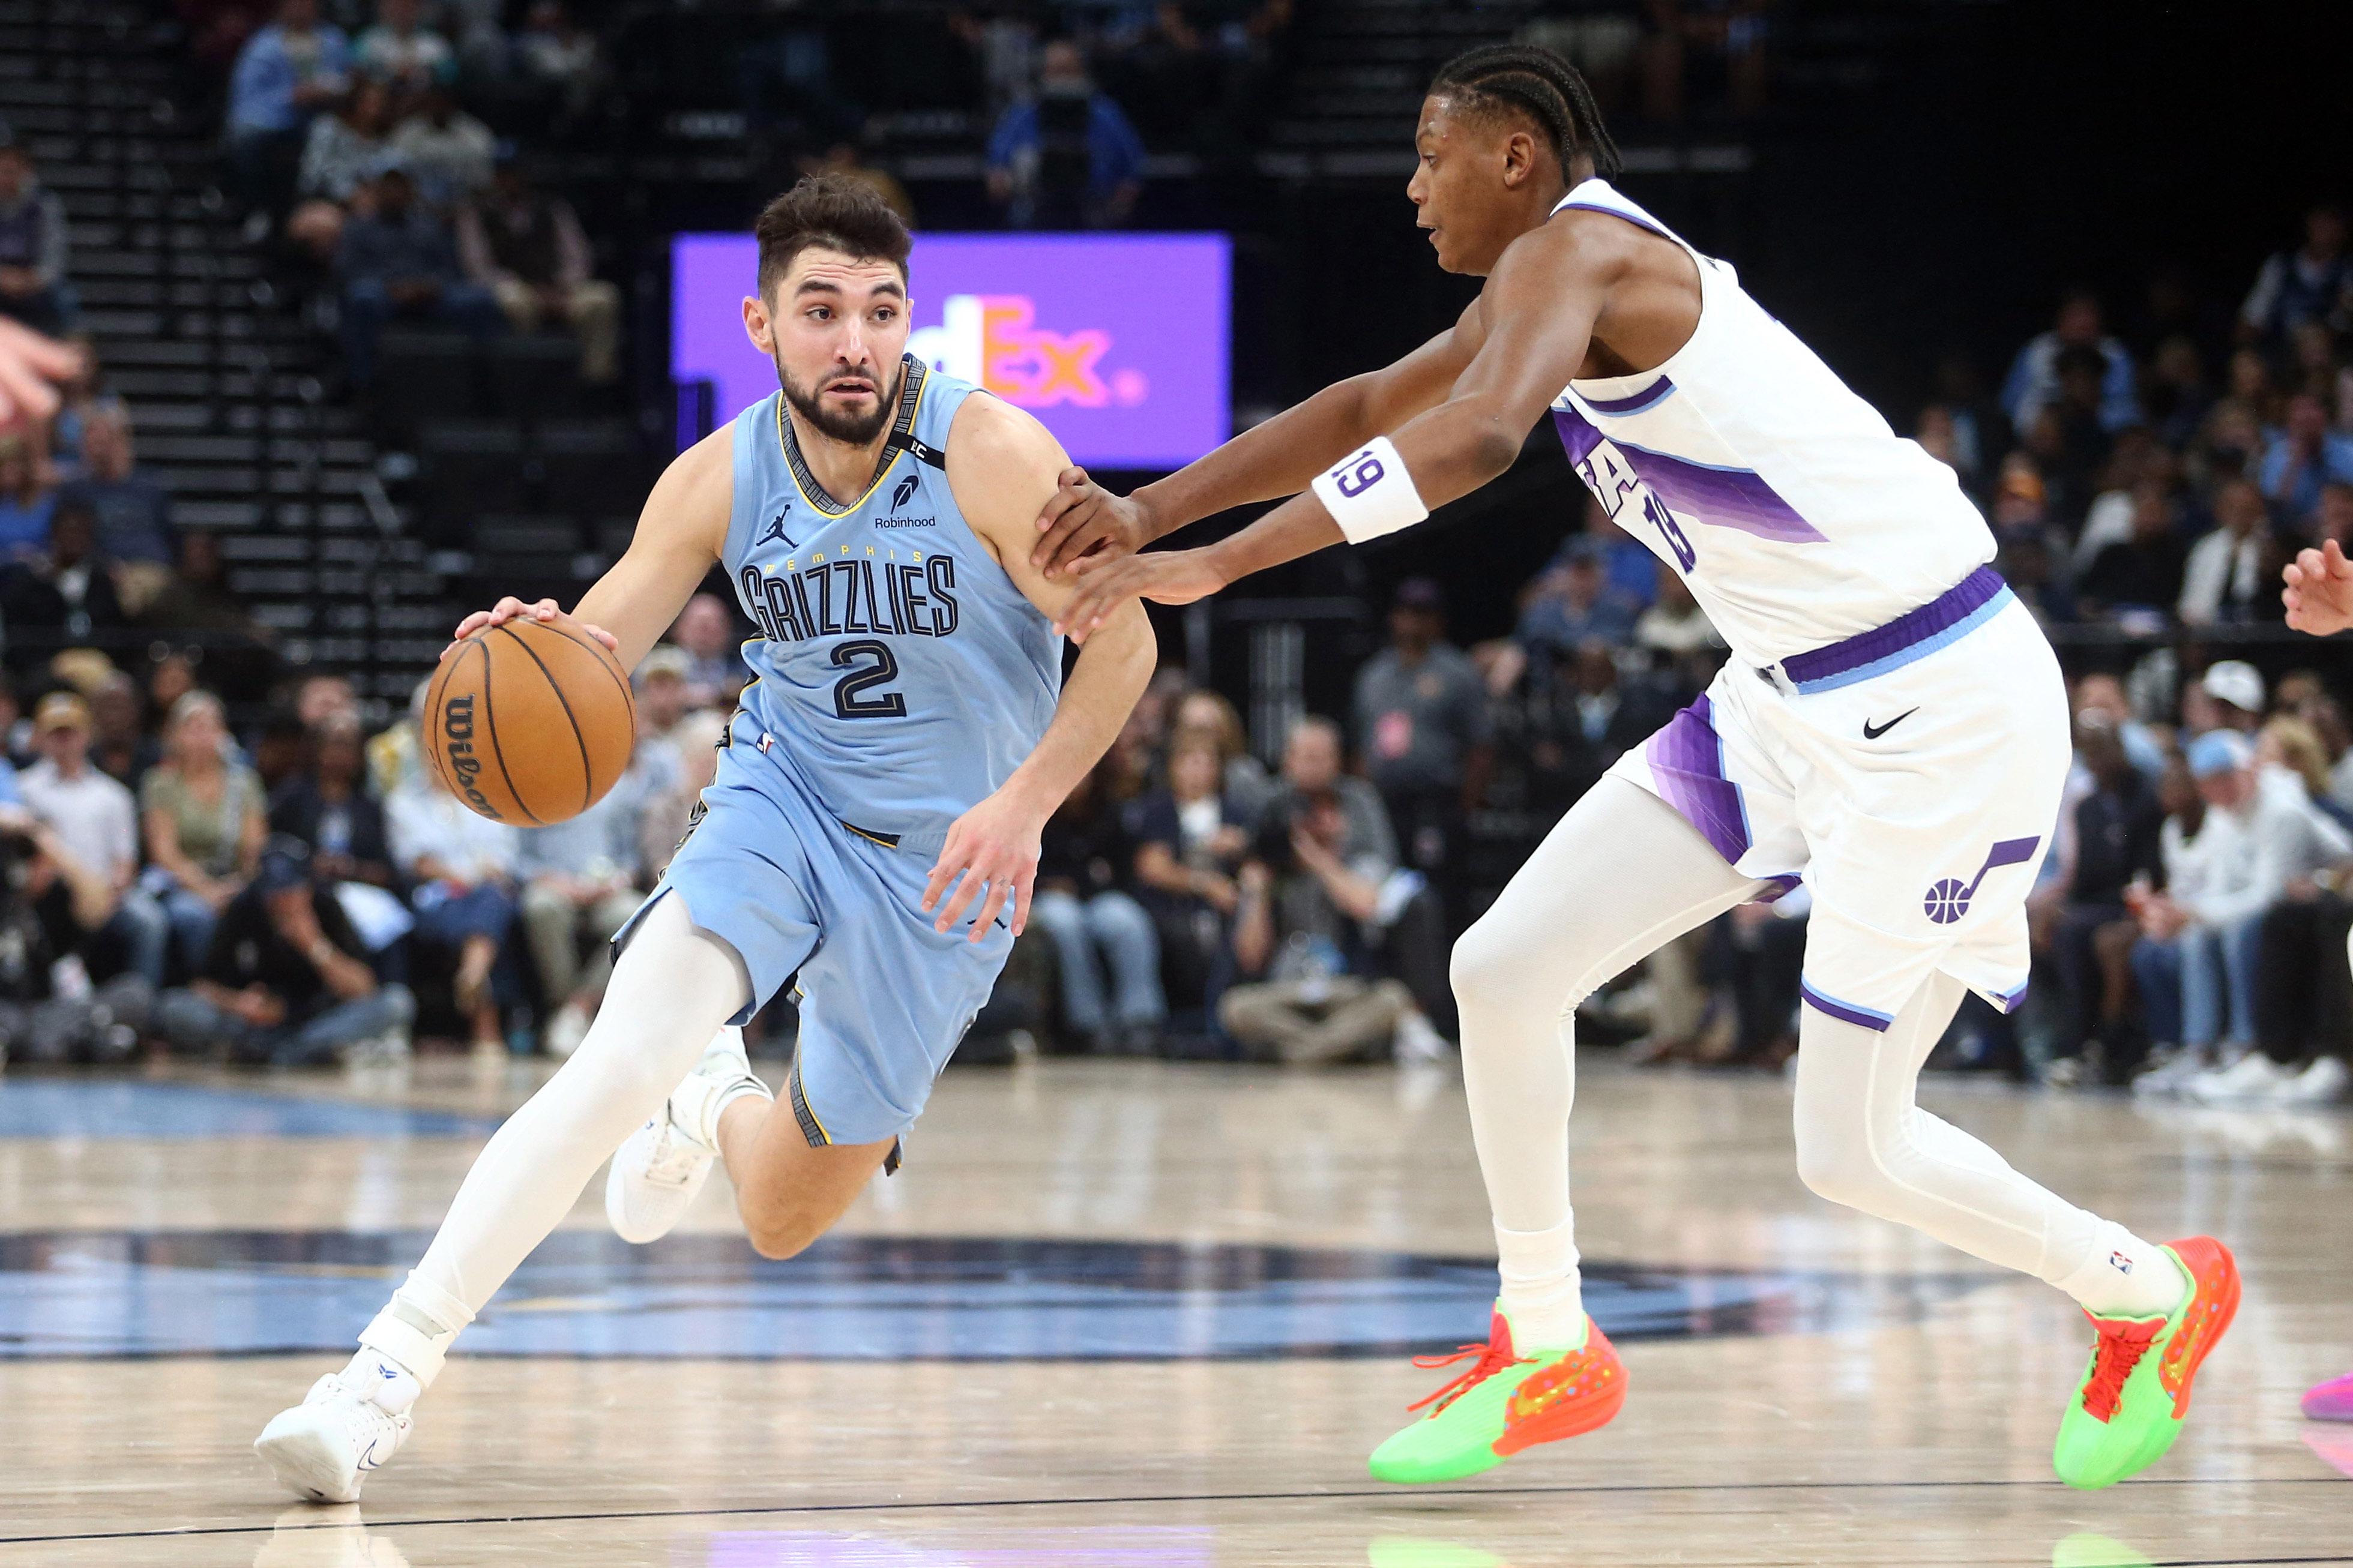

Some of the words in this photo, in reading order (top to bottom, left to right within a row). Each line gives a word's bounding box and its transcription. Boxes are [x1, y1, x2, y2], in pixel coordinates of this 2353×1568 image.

[899, 293, 1112, 407] dEx
[1331, 450, 1385, 498] 19
[875, 516, 936, 529] Robinhood
[1642, 489, 1698, 575] 19
[741, 554, 959, 643] GRIZZLIES
[830, 639, 908, 718] 2
[445, 693, 504, 818] Wilson
